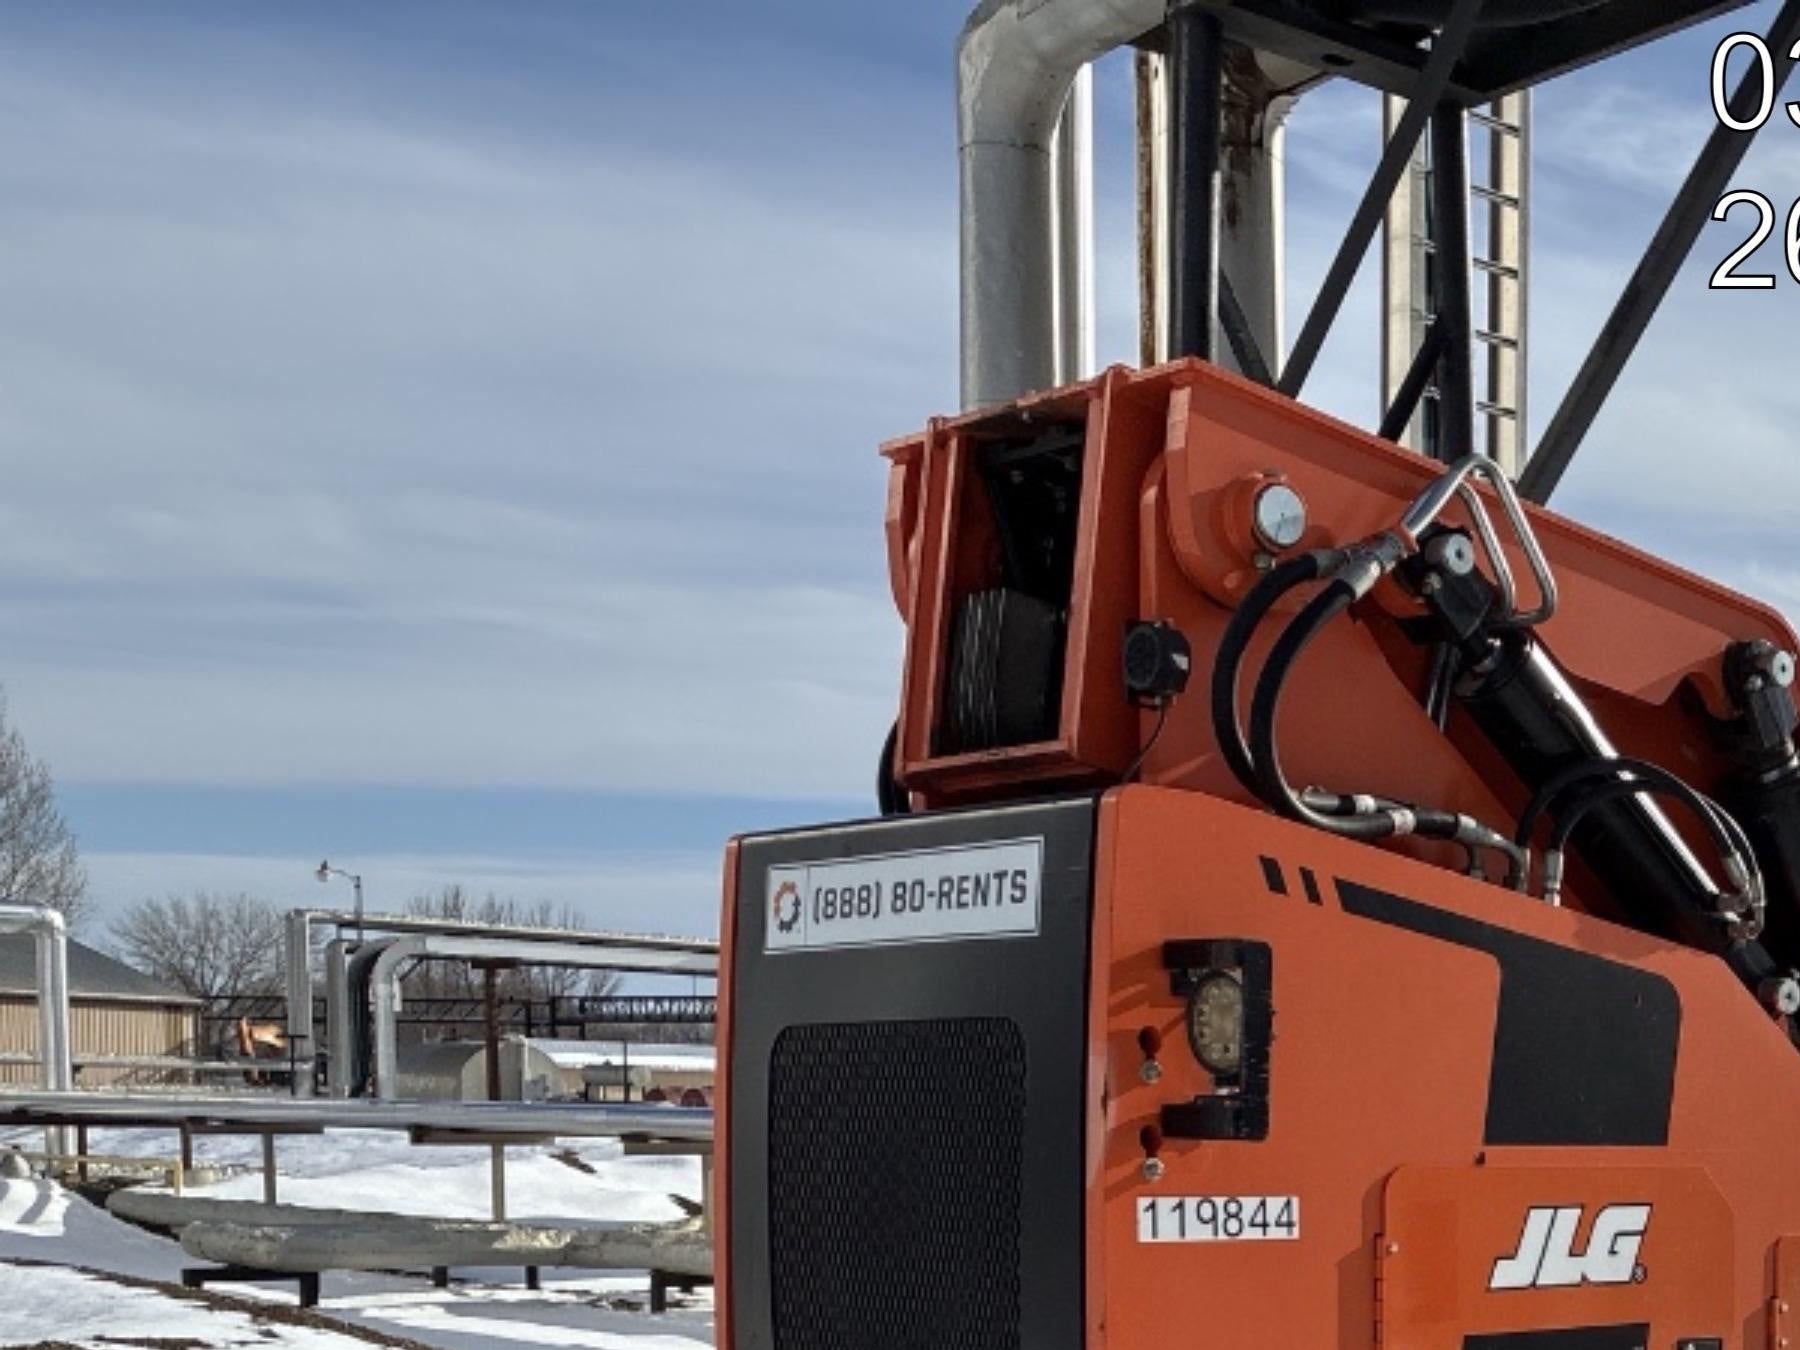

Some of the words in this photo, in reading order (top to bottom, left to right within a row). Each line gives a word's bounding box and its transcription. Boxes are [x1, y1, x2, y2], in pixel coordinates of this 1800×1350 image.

[812, 883, 881, 926] (888)
[890, 869, 1028, 915] 80-RENTS
[1141, 1198, 1297, 1240] 119844
[1488, 1203, 1652, 1291] JLG
